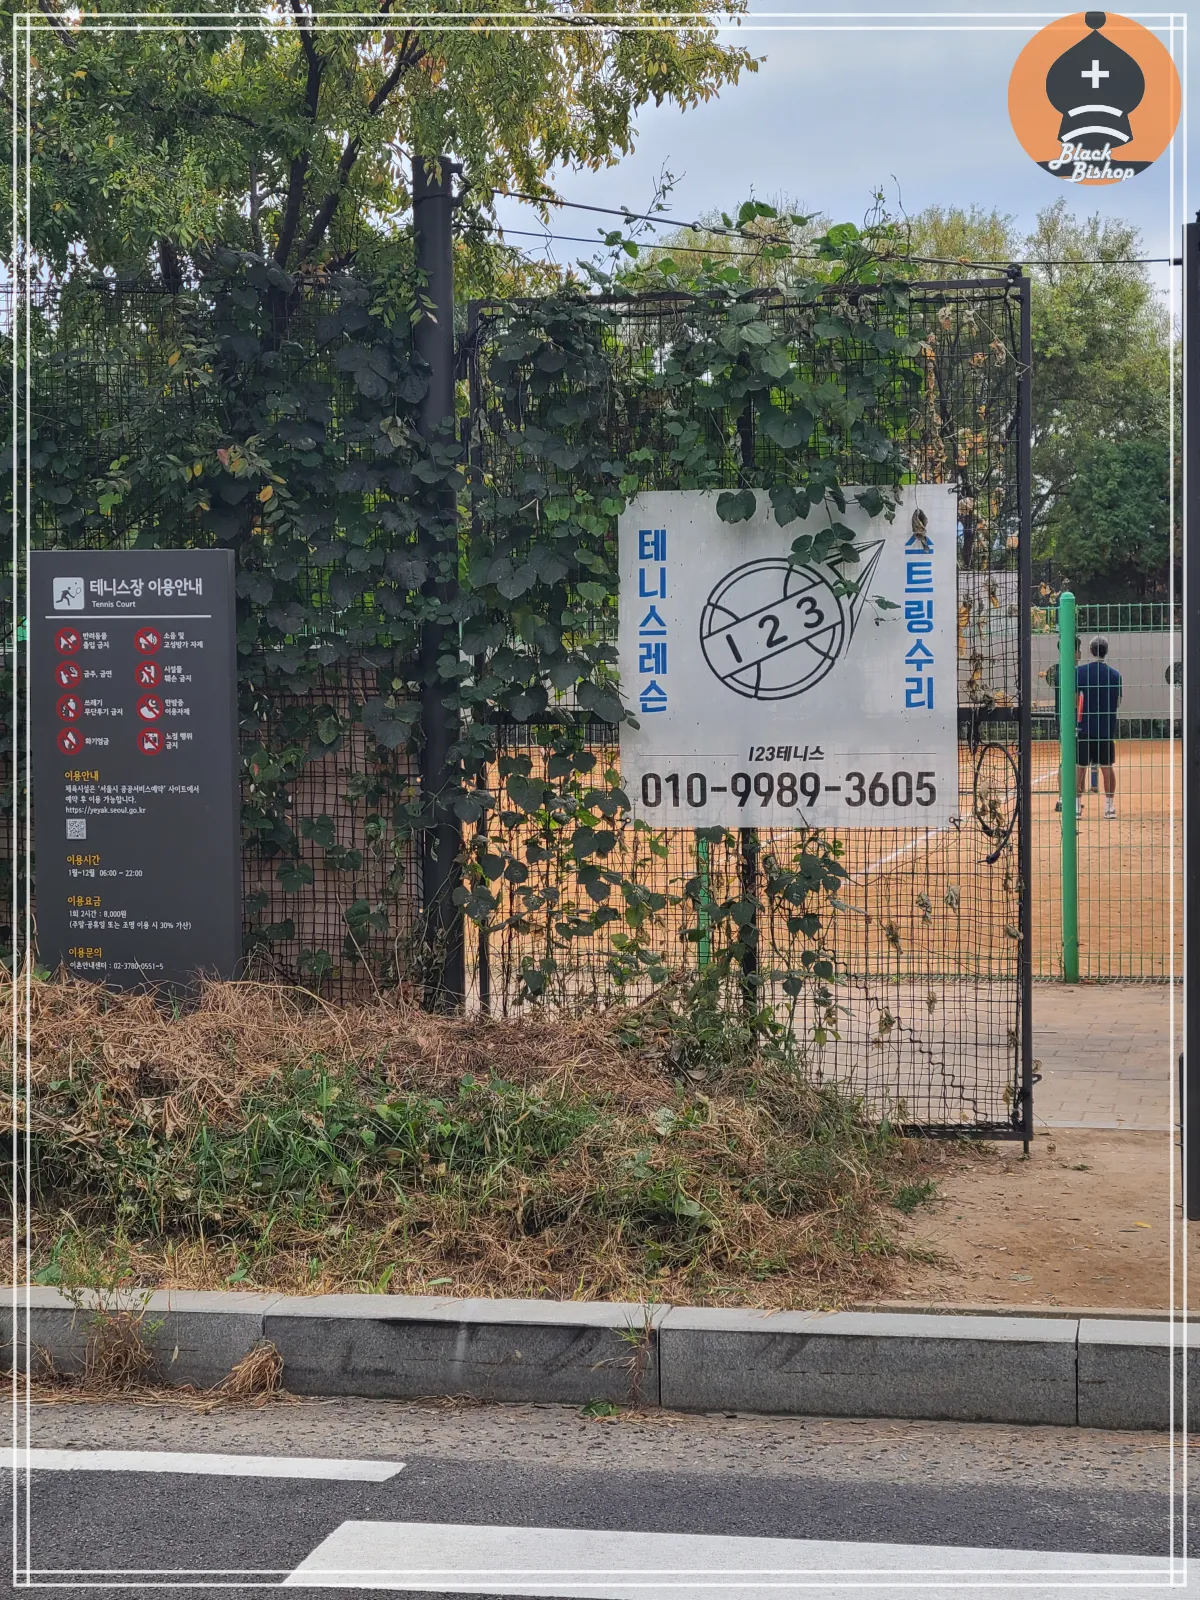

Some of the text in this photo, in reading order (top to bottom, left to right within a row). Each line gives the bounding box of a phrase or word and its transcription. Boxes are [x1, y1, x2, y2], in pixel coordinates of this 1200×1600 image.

[89, 577, 203, 597] 테니스장 이용안내
[92, 600, 136, 608] Tennis Court
[82, 632, 108, 640] 반려동물
[163, 632, 185, 640] 소음 및
[82, 641, 110, 649] 출입 금지
[163, 641, 204, 649] 고성방가 자제
[83, 669, 112, 678] 금주, 금연
[164, 665, 183, 674] 시설물
[164, 674, 192, 683] 훼손 금지
[84, 699, 103, 707] 쓰레기
[164, 699, 184, 707] 한밤중
[84, 708, 123, 716] 무단투기 금지
[164, 708, 190, 716] 이용자제
[165, 732, 193, 741] 노점 행위
[84, 737, 110, 746] 화기엄금
[748, 745, 825, 762] 123테니스
[64, 770, 99, 782] 이용안내
[65, 785, 96, 794] 체육시설은
[168, 785, 200, 794] 사이트에서
[641, 770, 937, 808] 010-9989-3605
[65, 795, 137, 804] 예약 후 이용 가능합니다.
[65, 806, 146, 815] https://yeyak.seoul.go.kr
[66, 854, 100, 866] 이용시간
[125, 869, 143, 877] 22:00
[67, 895, 101, 907] 이용요금
[69, 910, 79, 918] 1회
[80, 910, 97, 918] 2시간
[103, 910, 127, 919] 8,000원
[107, 921, 120, 929] 또는
[122, 921, 135, 930] 조명
[136, 921, 150, 930] 이용
[151, 921, 158, 930] 시
[175, 921, 192, 931] 가산)
[68, 947, 102, 959] 이용문의
[69, 961, 107, 970] 이촌안내센터
